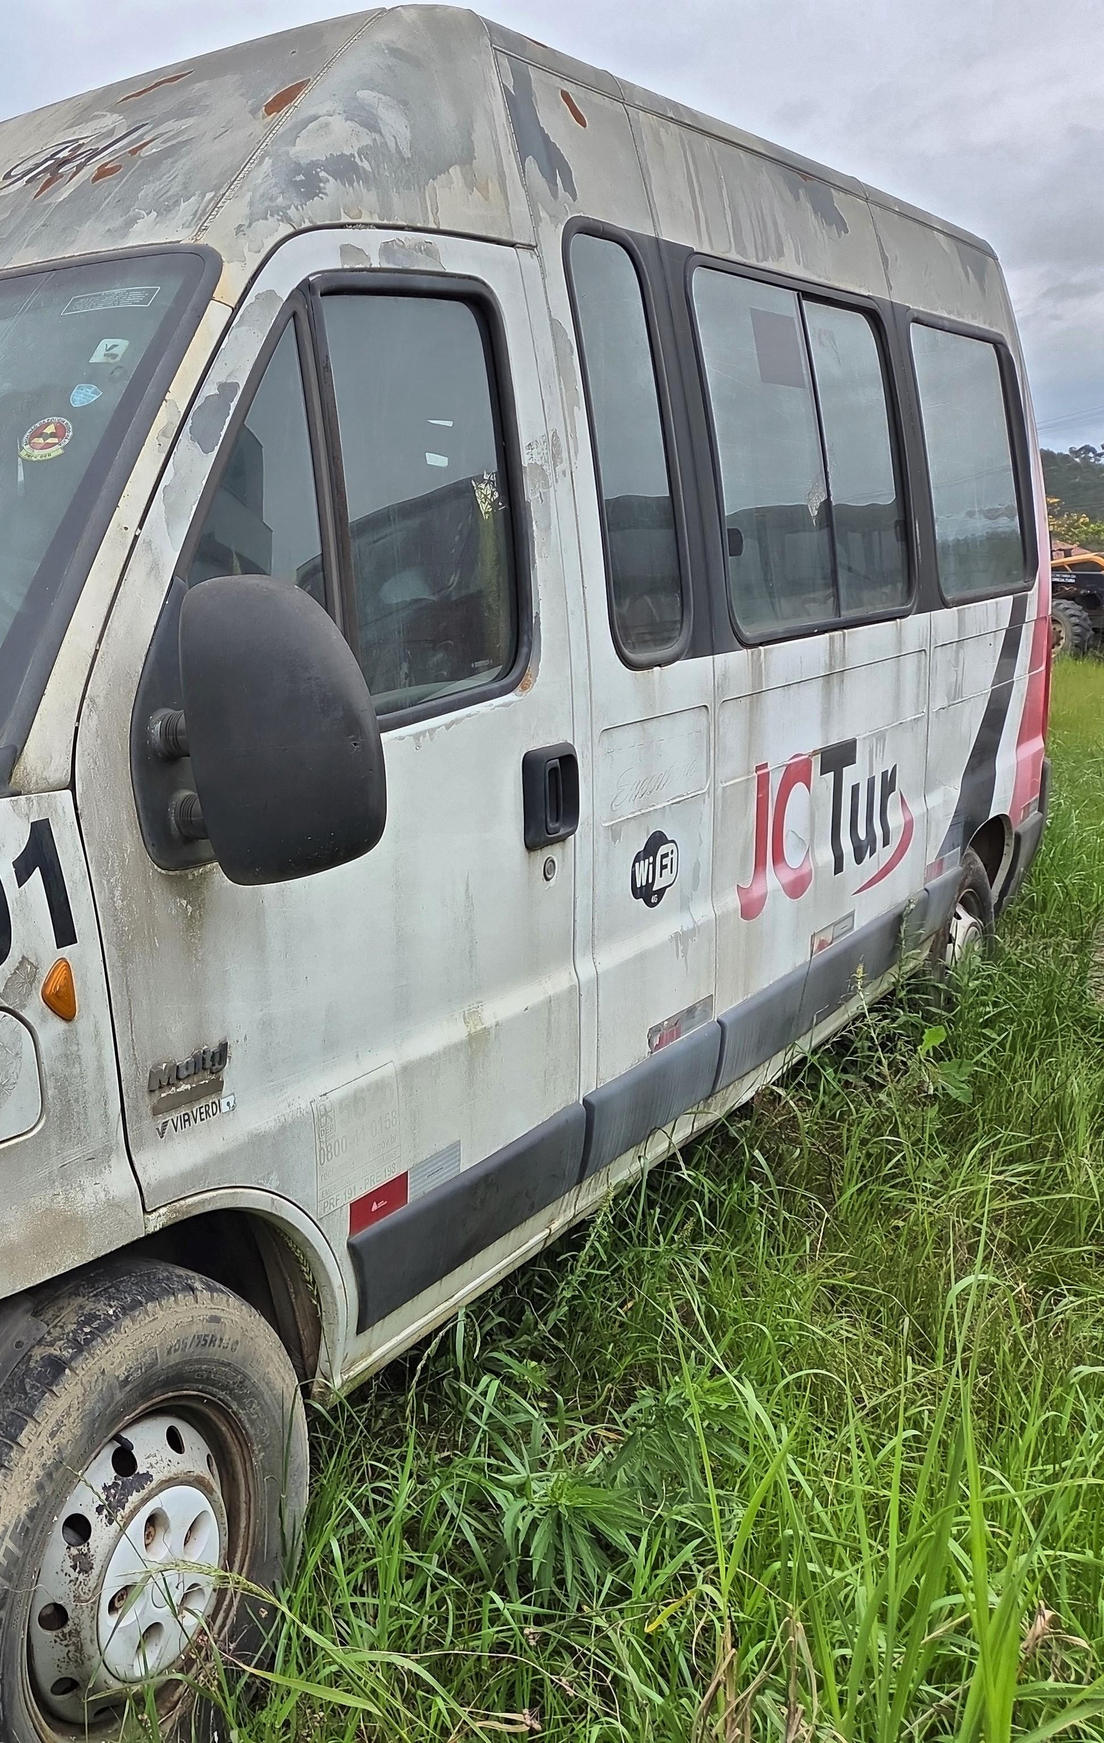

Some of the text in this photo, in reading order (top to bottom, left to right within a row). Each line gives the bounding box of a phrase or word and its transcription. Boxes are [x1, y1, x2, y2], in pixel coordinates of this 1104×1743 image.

[736, 737, 898, 921] JC Tur
[343, 1184, 357, 1203] 191
